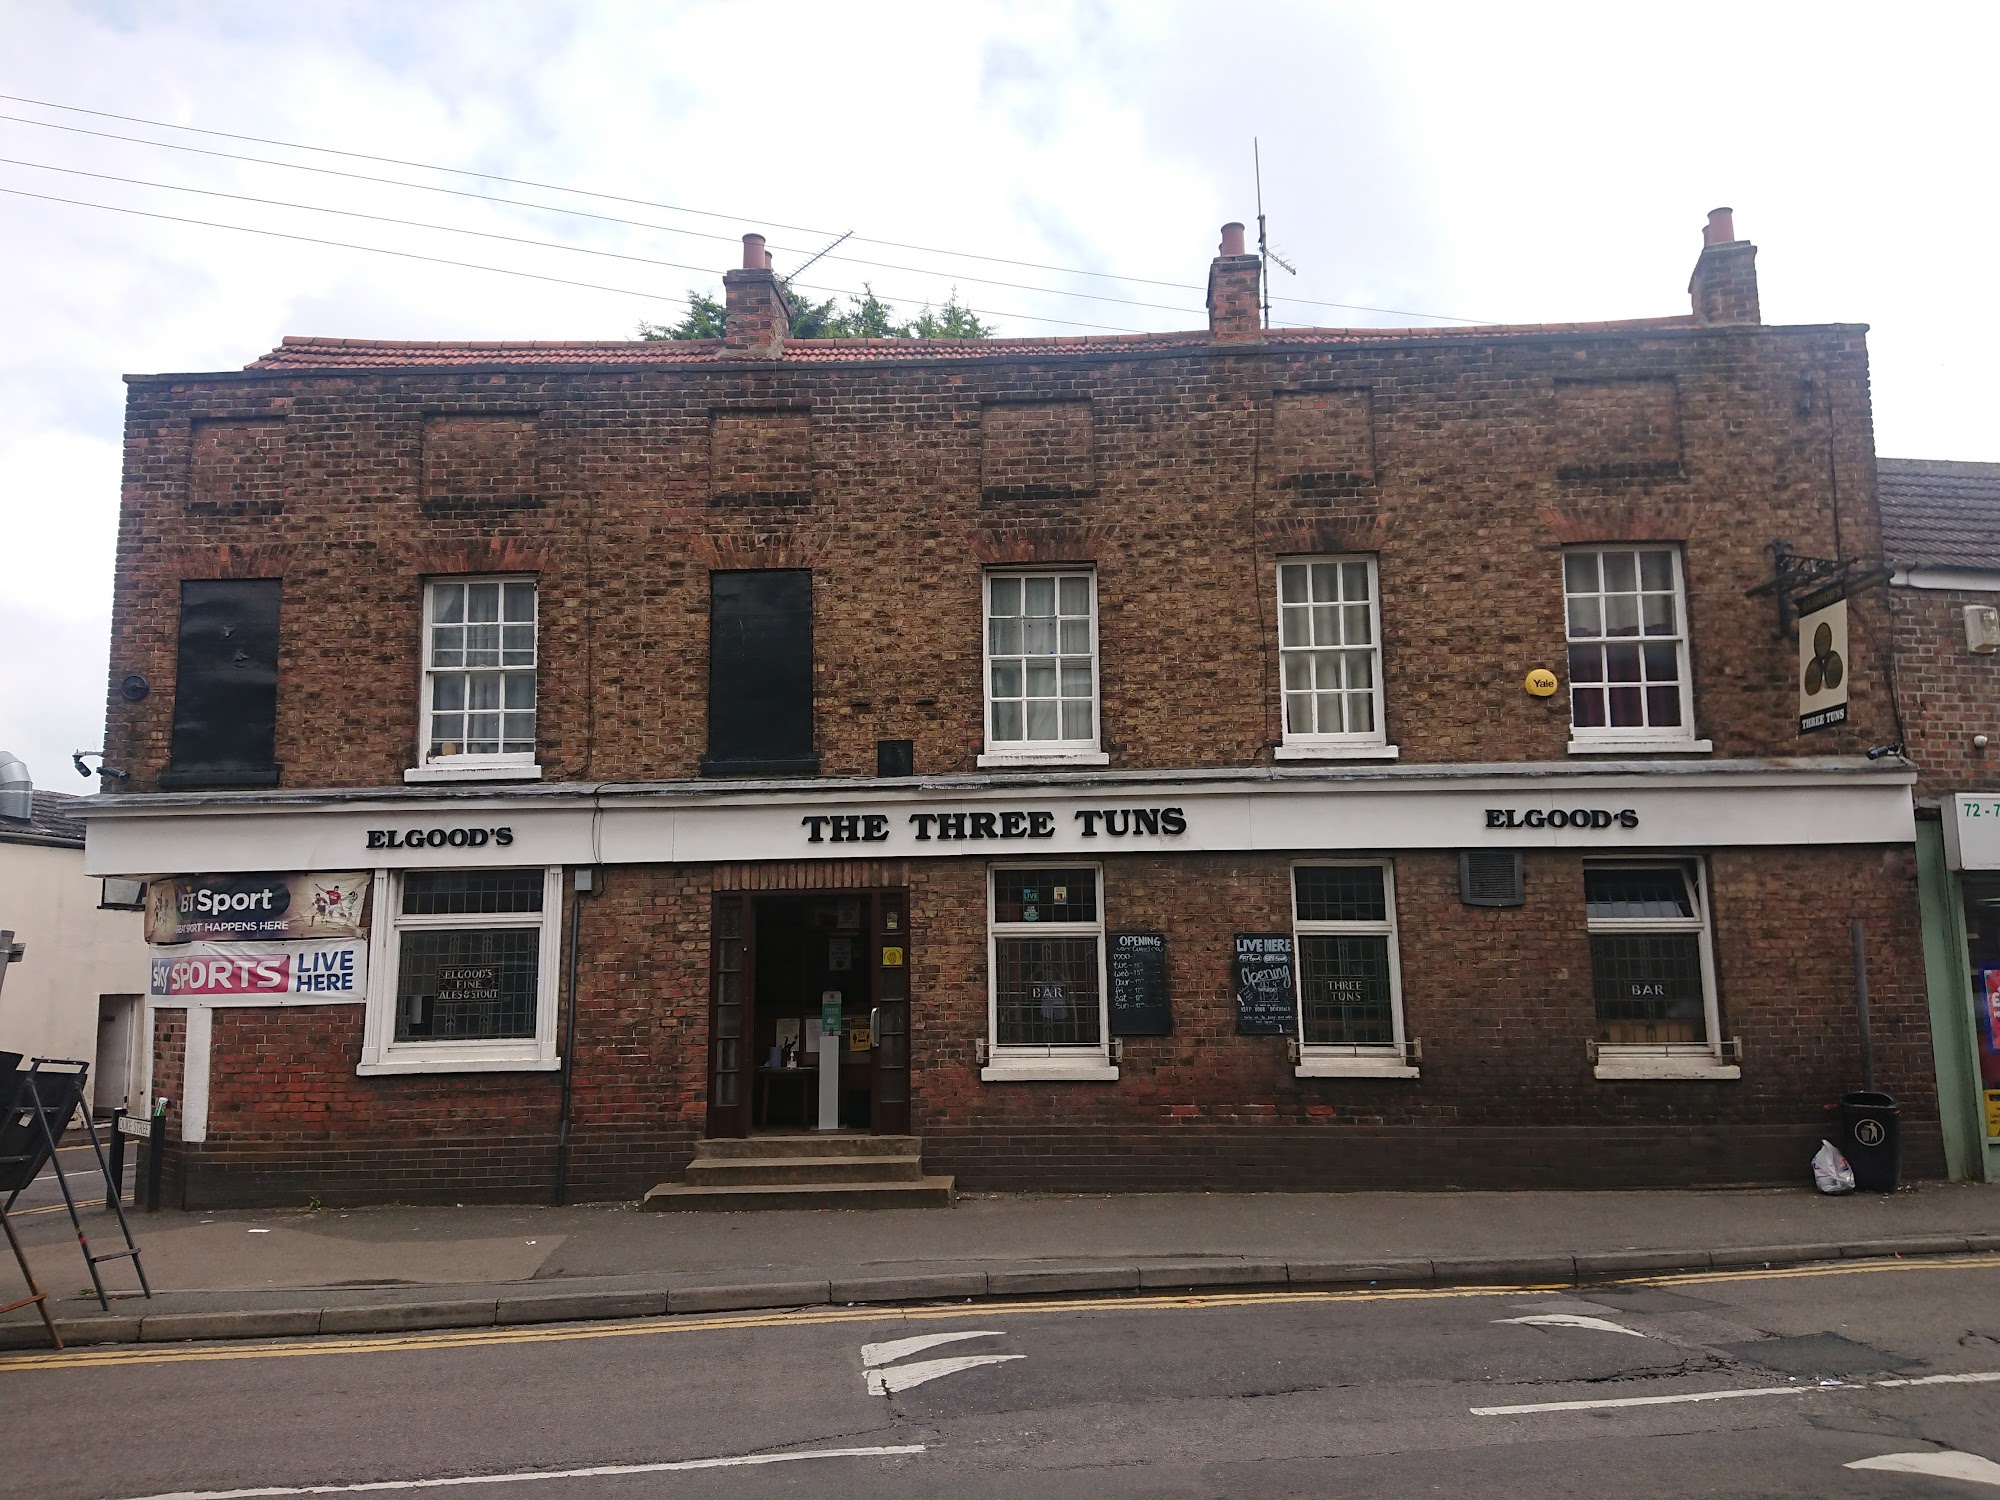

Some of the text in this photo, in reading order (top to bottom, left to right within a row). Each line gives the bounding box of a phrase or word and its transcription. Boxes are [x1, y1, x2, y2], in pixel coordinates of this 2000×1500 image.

[1533, 679, 1555, 688] Yale
[1801, 708, 1845, 730] THREE TUNS
[1963, 803, 1981, 817] 72
[801, 807, 1188, 842] THE THREE TUNS
[1485, 809, 1639, 829] ELGOOD'S
[366, 827, 514, 849] ELGOOD'S
[181, 887, 273, 915] BT Sport
[204, 921, 257, 932] HAPPENS
[259, 920, 289, 931] HERE
[1119, 935, 1161, 946] OPENING
[1236, 938, 1291, 952] LIVE HERE
[298, 950, 354, 972] LIVE
[152, 959, 282, 993] sky SPORTS
[445, 968, 493, 979] ELGOOD'S
[1241, 964, 1291, 988] Opening
[296, 972, 354, 992] HERE
[456, 980, 481, 989] FINE
[1328, 980, 1363, 990] THREE
[1033, 987, 1063, 998] BAR
[1331, 991, 1362, 1001] TUNS
[1631, 984, 1665, 995] BAR
